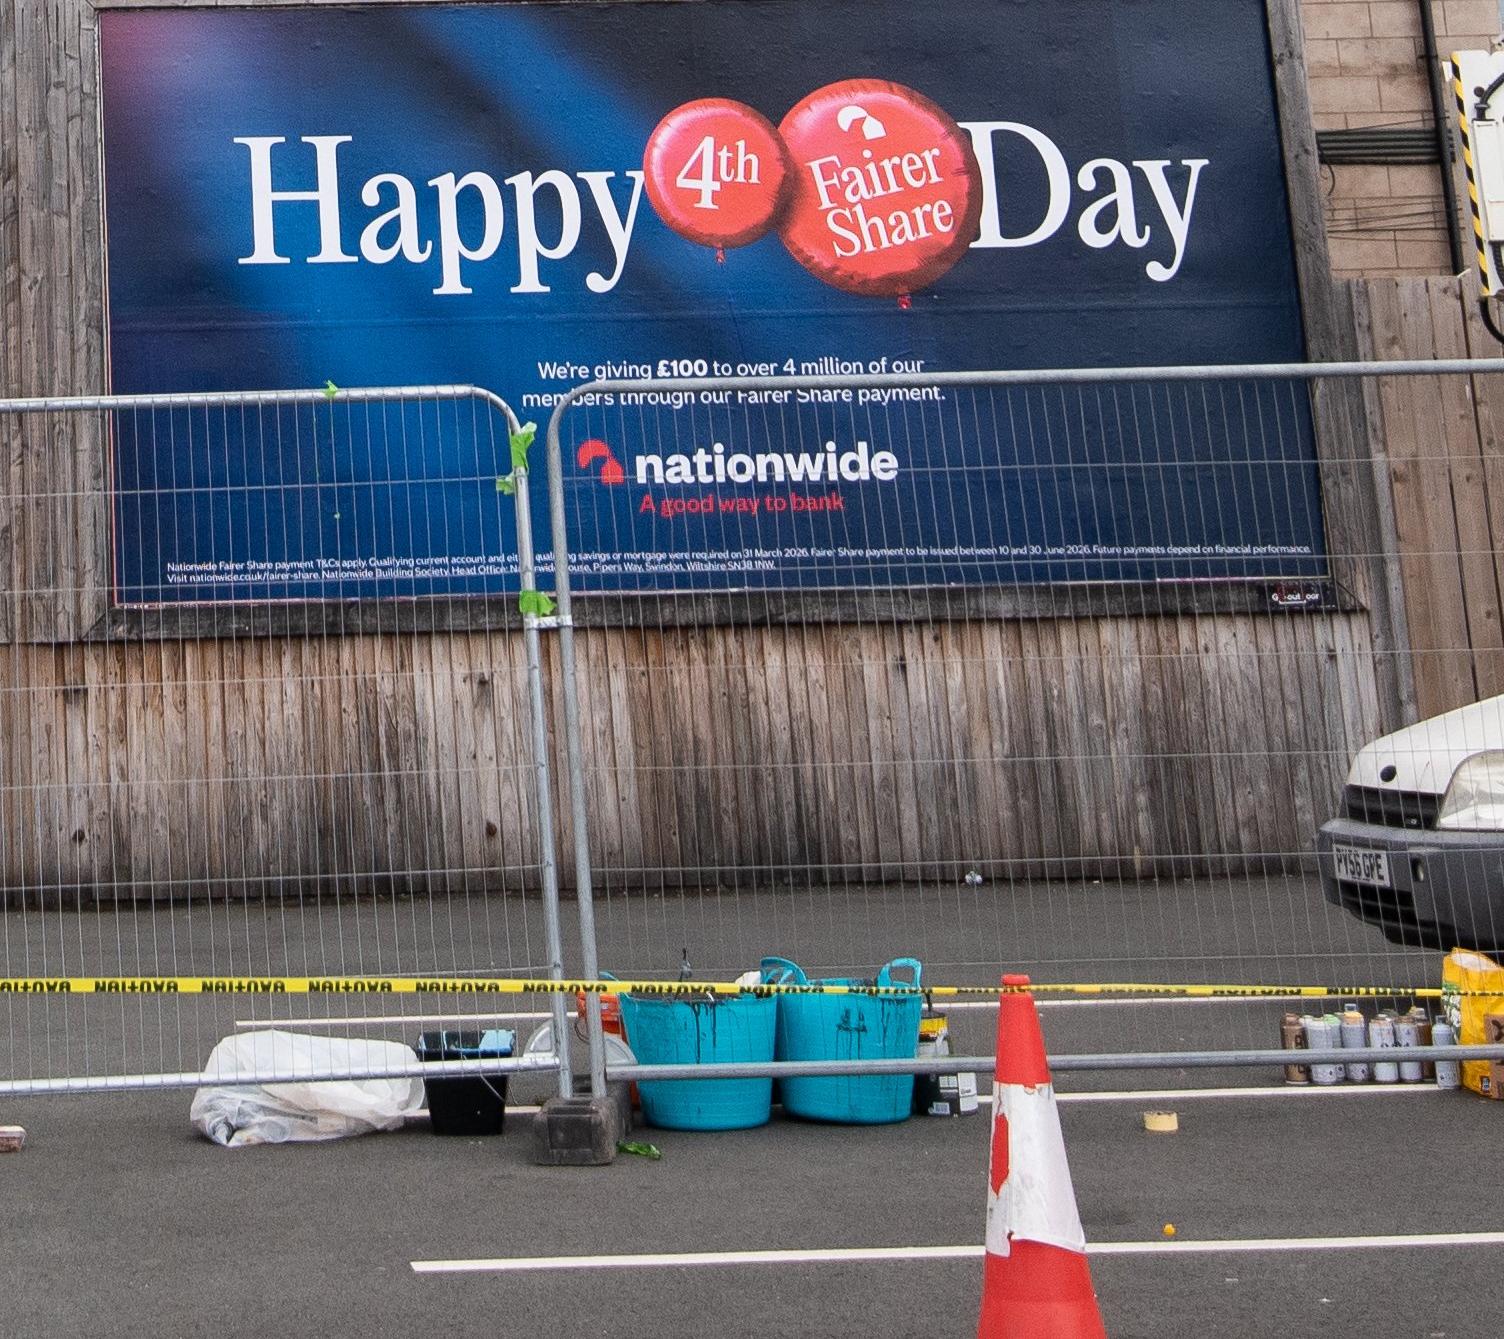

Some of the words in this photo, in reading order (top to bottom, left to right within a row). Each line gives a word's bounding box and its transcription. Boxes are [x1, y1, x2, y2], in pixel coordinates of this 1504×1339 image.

[676, 135, 760, 212] 4th
[805, 143, 944, 215] Fairer
[233, 135, 645, 296] Happy
[964, 120, 1211, 283] Day
[825, 194, 955, 261] Share
[538, 360, 590, 382] We're
[594, 362, 652, 383] giving
[657, 360, 708, 377] £100
[713, 359, 732, 377] to
[737, 359, 777, 376] over
[782, 359, 795, 375] 4
[801, 358, 863, 374] million
[868, 357, 889, 373] of
[892, 359, 924, 374] our
[700, 389, 731, 404] our
[858, 386, 946, 404] payment.
[636, 441, 898, 483] nationwide
[640, 495, 655, 513] A
[661, 496, 714, 517] good
[719, 497, 759, 515] way
[765, 494, 786, 511] to
[792, 492, 845, 510] bank
[167, 560, 217, 572] Nationwide
[246, 558, 274, 570] Share
[275, 557, 314, 572] payment
[342, 556, 368, 570] apply.
[416, 554, 449, 566] current
[451, 553, 486, 564] account
[488, 552, 505, 563] and
[578, 550, 611, 564] savings
[612, 552, 622, 560] or
[624, 549, 667, 563] mortgage
[668, 551, 690, 560] were
[743, 547, 752, 558] 31
[755, 547, 782, 558] March
[838, 546, 864, 557] Share
[866, 546, 903, 560] payment
[905, 545, 915, 556] to
[917, 545, 928, 556] be
[930, 545, 958, 556] issued
[960, 545, 997, 556] between
[999, 545, 1009, 555] 10
[1011, 545, 1027, 555] and
[1029, 544, 1041, 555] 30
[1093, 544, 1122, 555] Future
[1123, 544, 1165, 558] payments
[1167, 543, 1200, 557] depend
[1215, 543, 1251, 554] financial
[1253, 543, 1311, 557] performance.
[167, 572, 187, 583] Visit
[451, 563, 476, 575] Head
